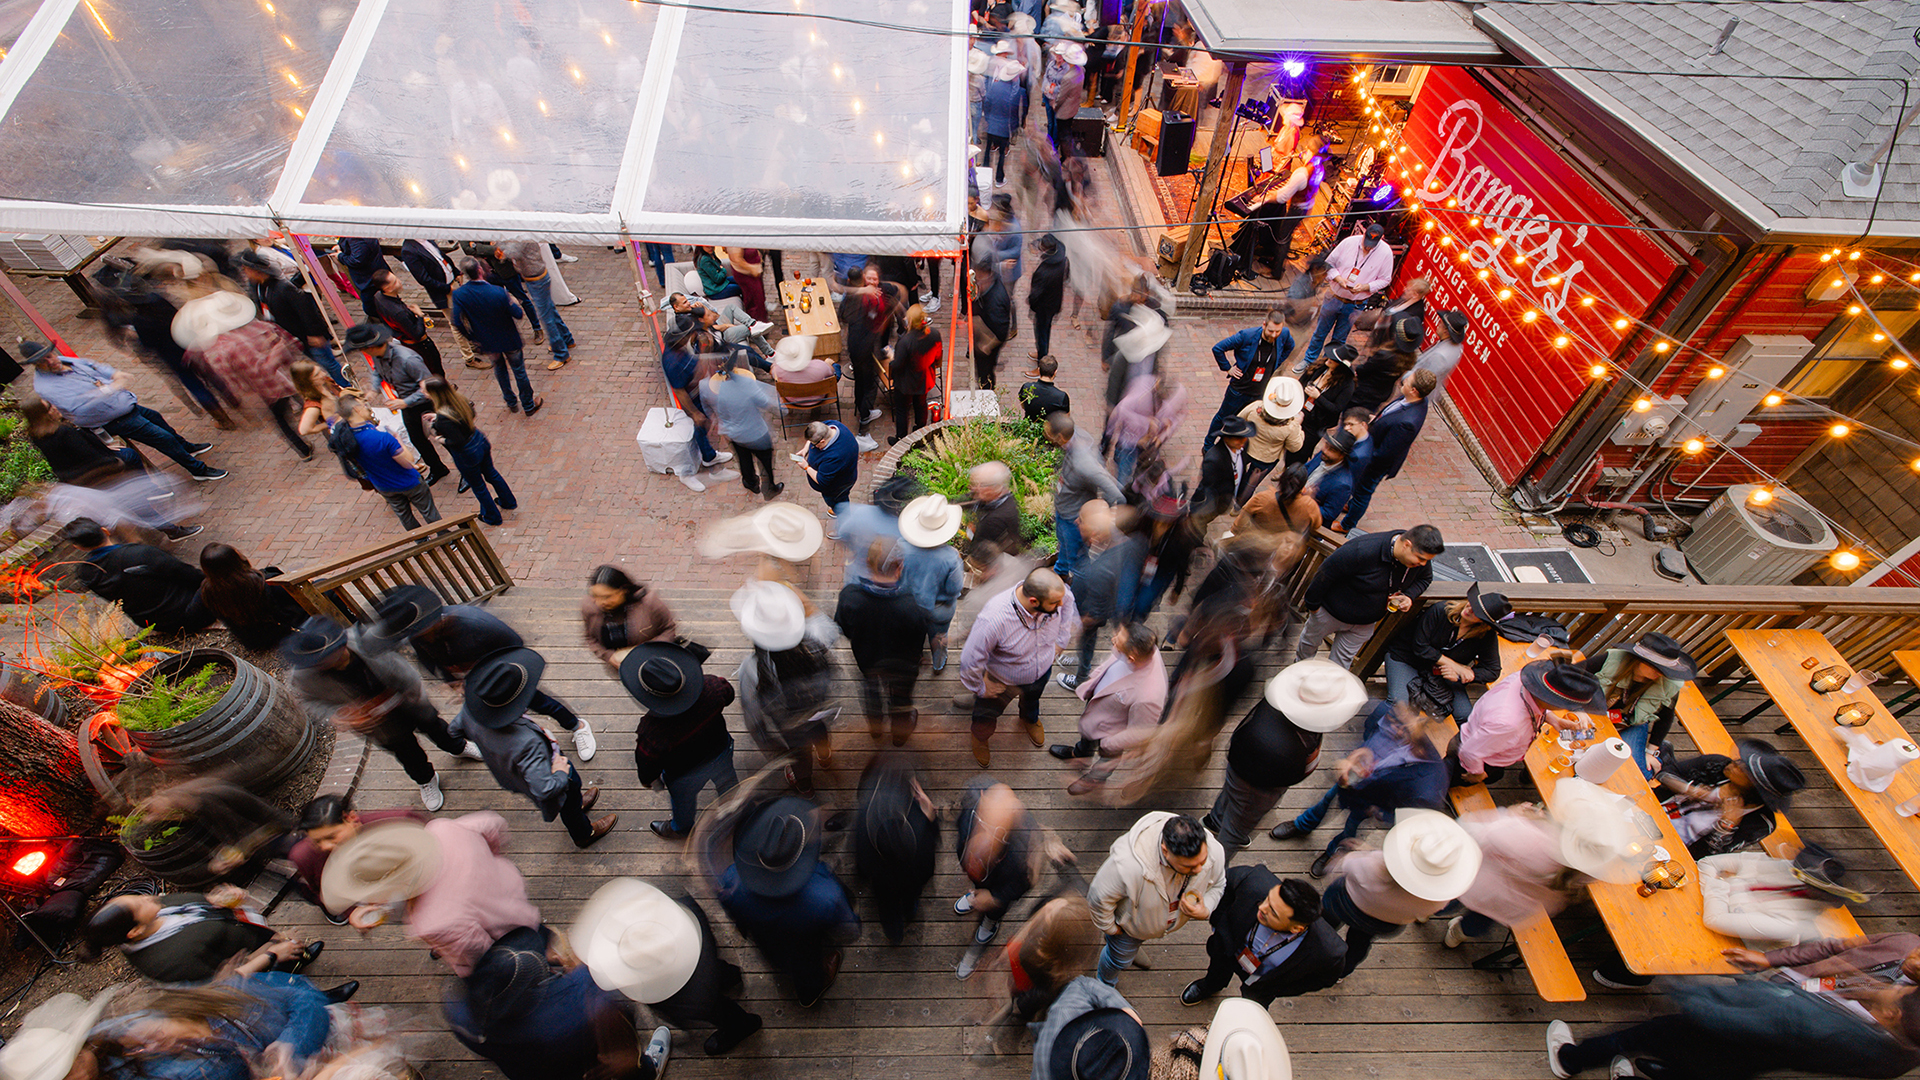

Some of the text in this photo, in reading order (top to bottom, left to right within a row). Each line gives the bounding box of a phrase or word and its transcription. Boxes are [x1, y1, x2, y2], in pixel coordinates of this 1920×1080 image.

[1416, 99, 1588, 325] Banger's
[1416, 259, 1491, 364] & BEER DEN
[1422, 234, 1508, 348] SAUSAGE HOUSE
